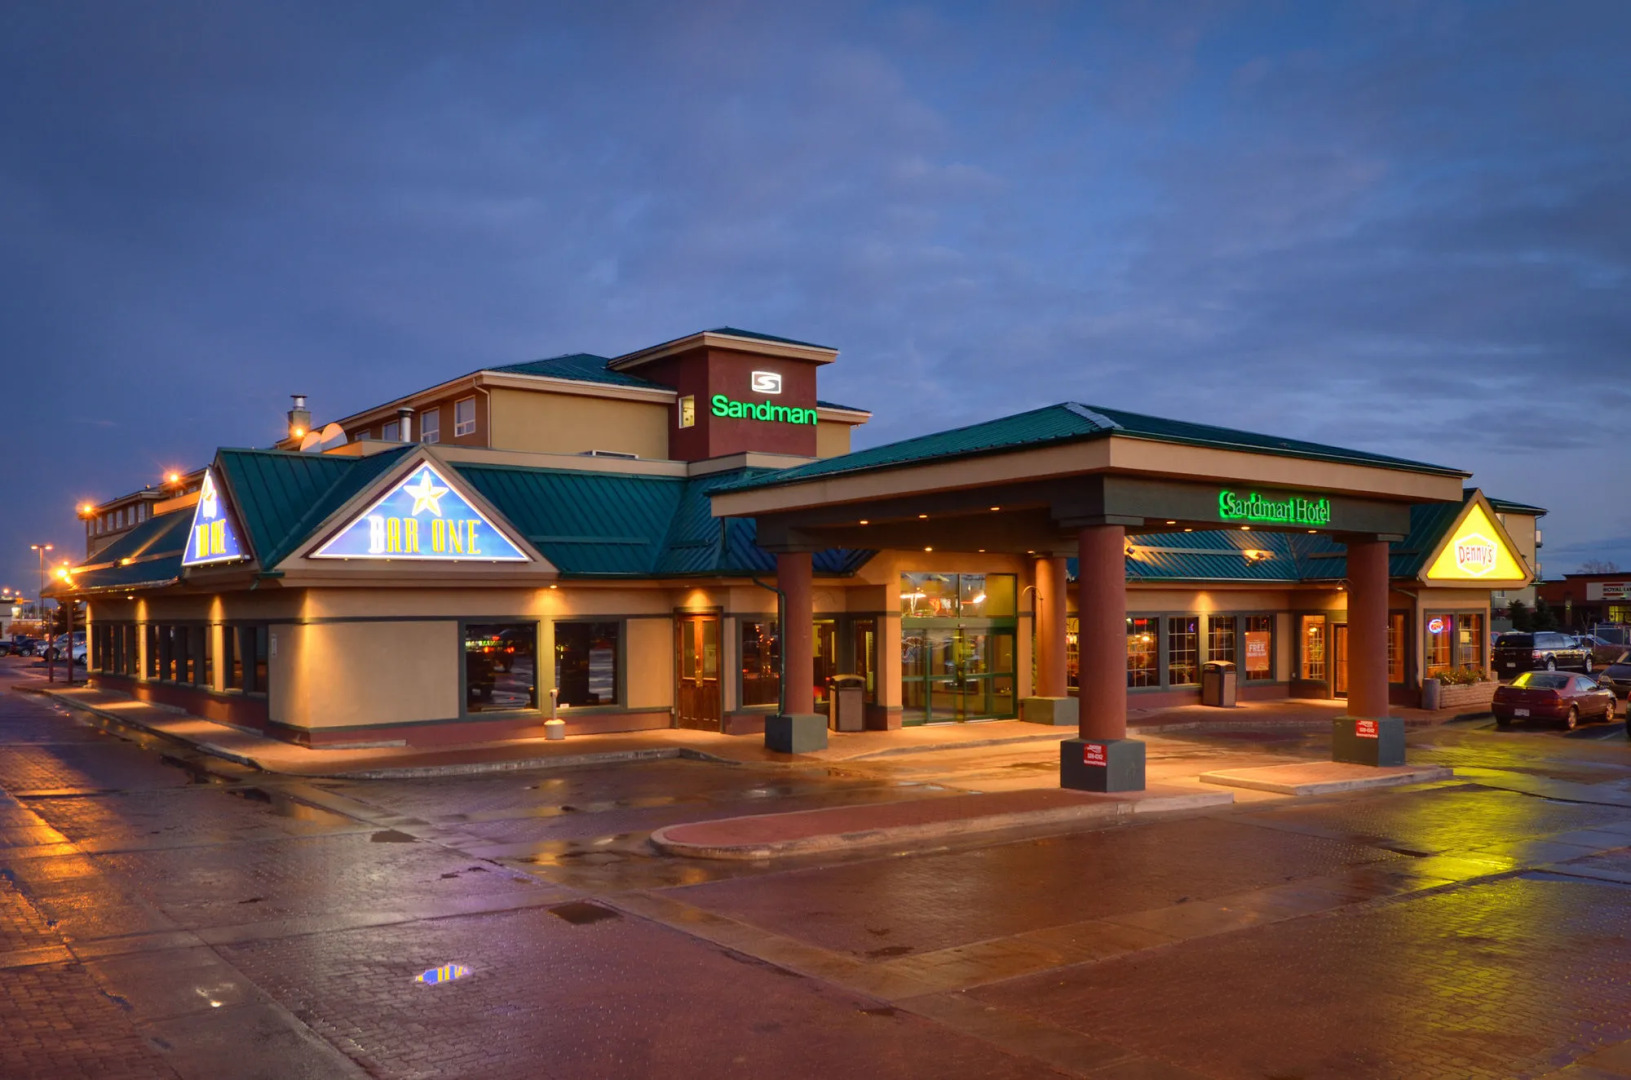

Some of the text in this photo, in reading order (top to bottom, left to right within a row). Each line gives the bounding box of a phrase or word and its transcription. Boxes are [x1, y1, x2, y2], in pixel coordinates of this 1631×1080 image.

[711, 394, 818, 425] Sandman
[1219, 490, 1330, 524] Sandman Hotel
[367, 514, 481, 554] BAR ONE
[1458, 543, 1493, 566] Denny's
[1248, 643, 1265, 652] FREE
